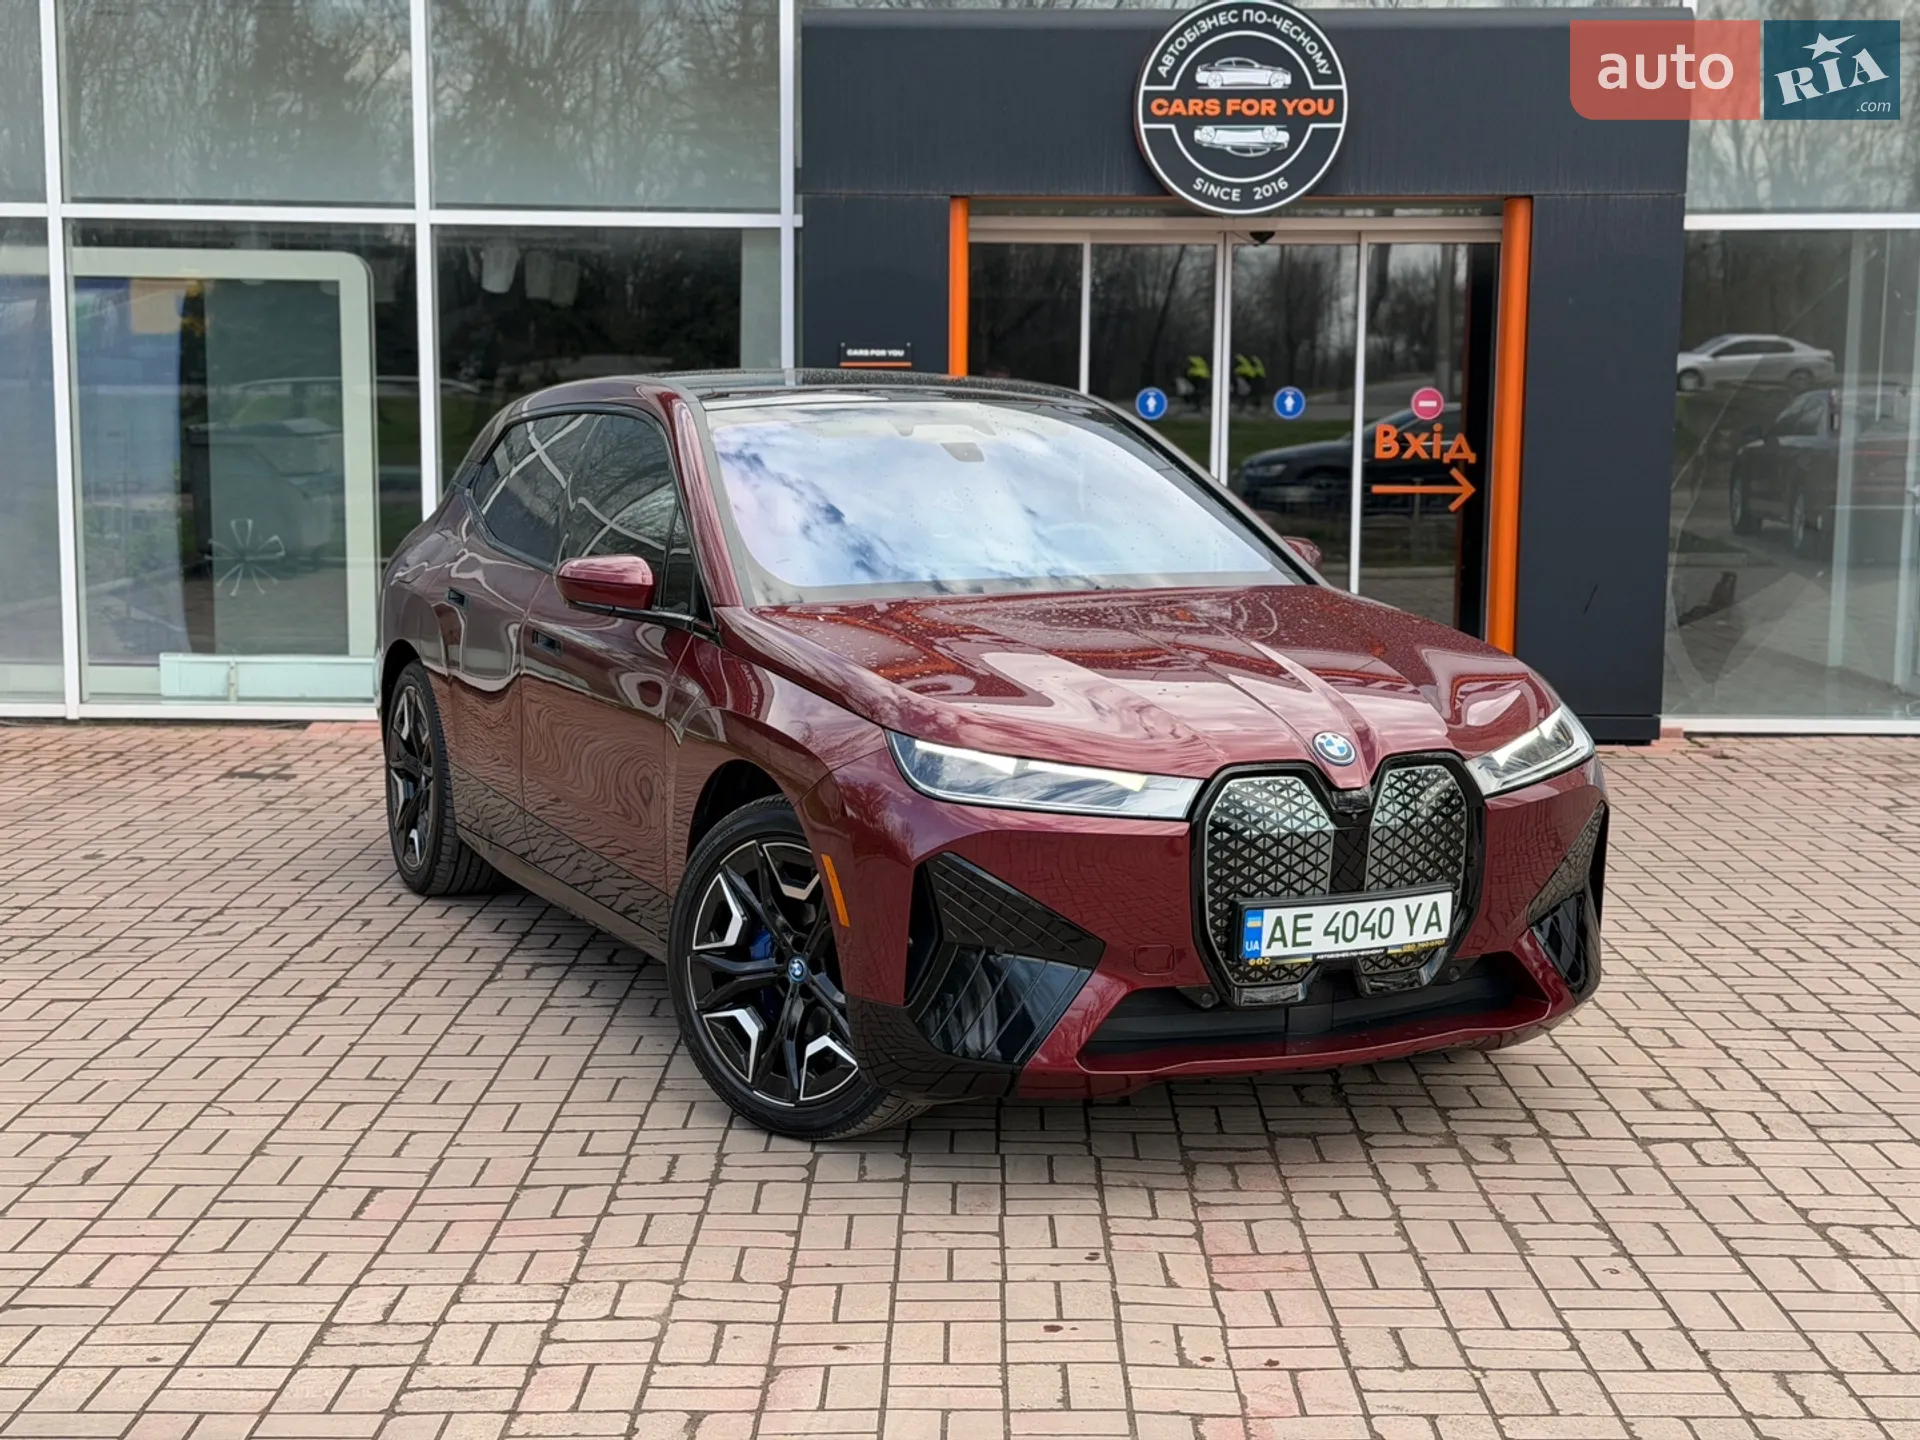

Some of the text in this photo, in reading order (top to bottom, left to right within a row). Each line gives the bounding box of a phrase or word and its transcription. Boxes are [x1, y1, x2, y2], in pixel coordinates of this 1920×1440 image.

[1157, 9, 1332, 78] АВТОБІЗНЕС ПО-ЧЕСНОМУ
[1150, 98, 1335, 116] CARS FOR YOU
[1193, 177, 1289, 202] SINCE 2016
[1374, 423, 1477, 464] Вхід
[1245, 901, 1443, 951] UA AE 4040 YA
